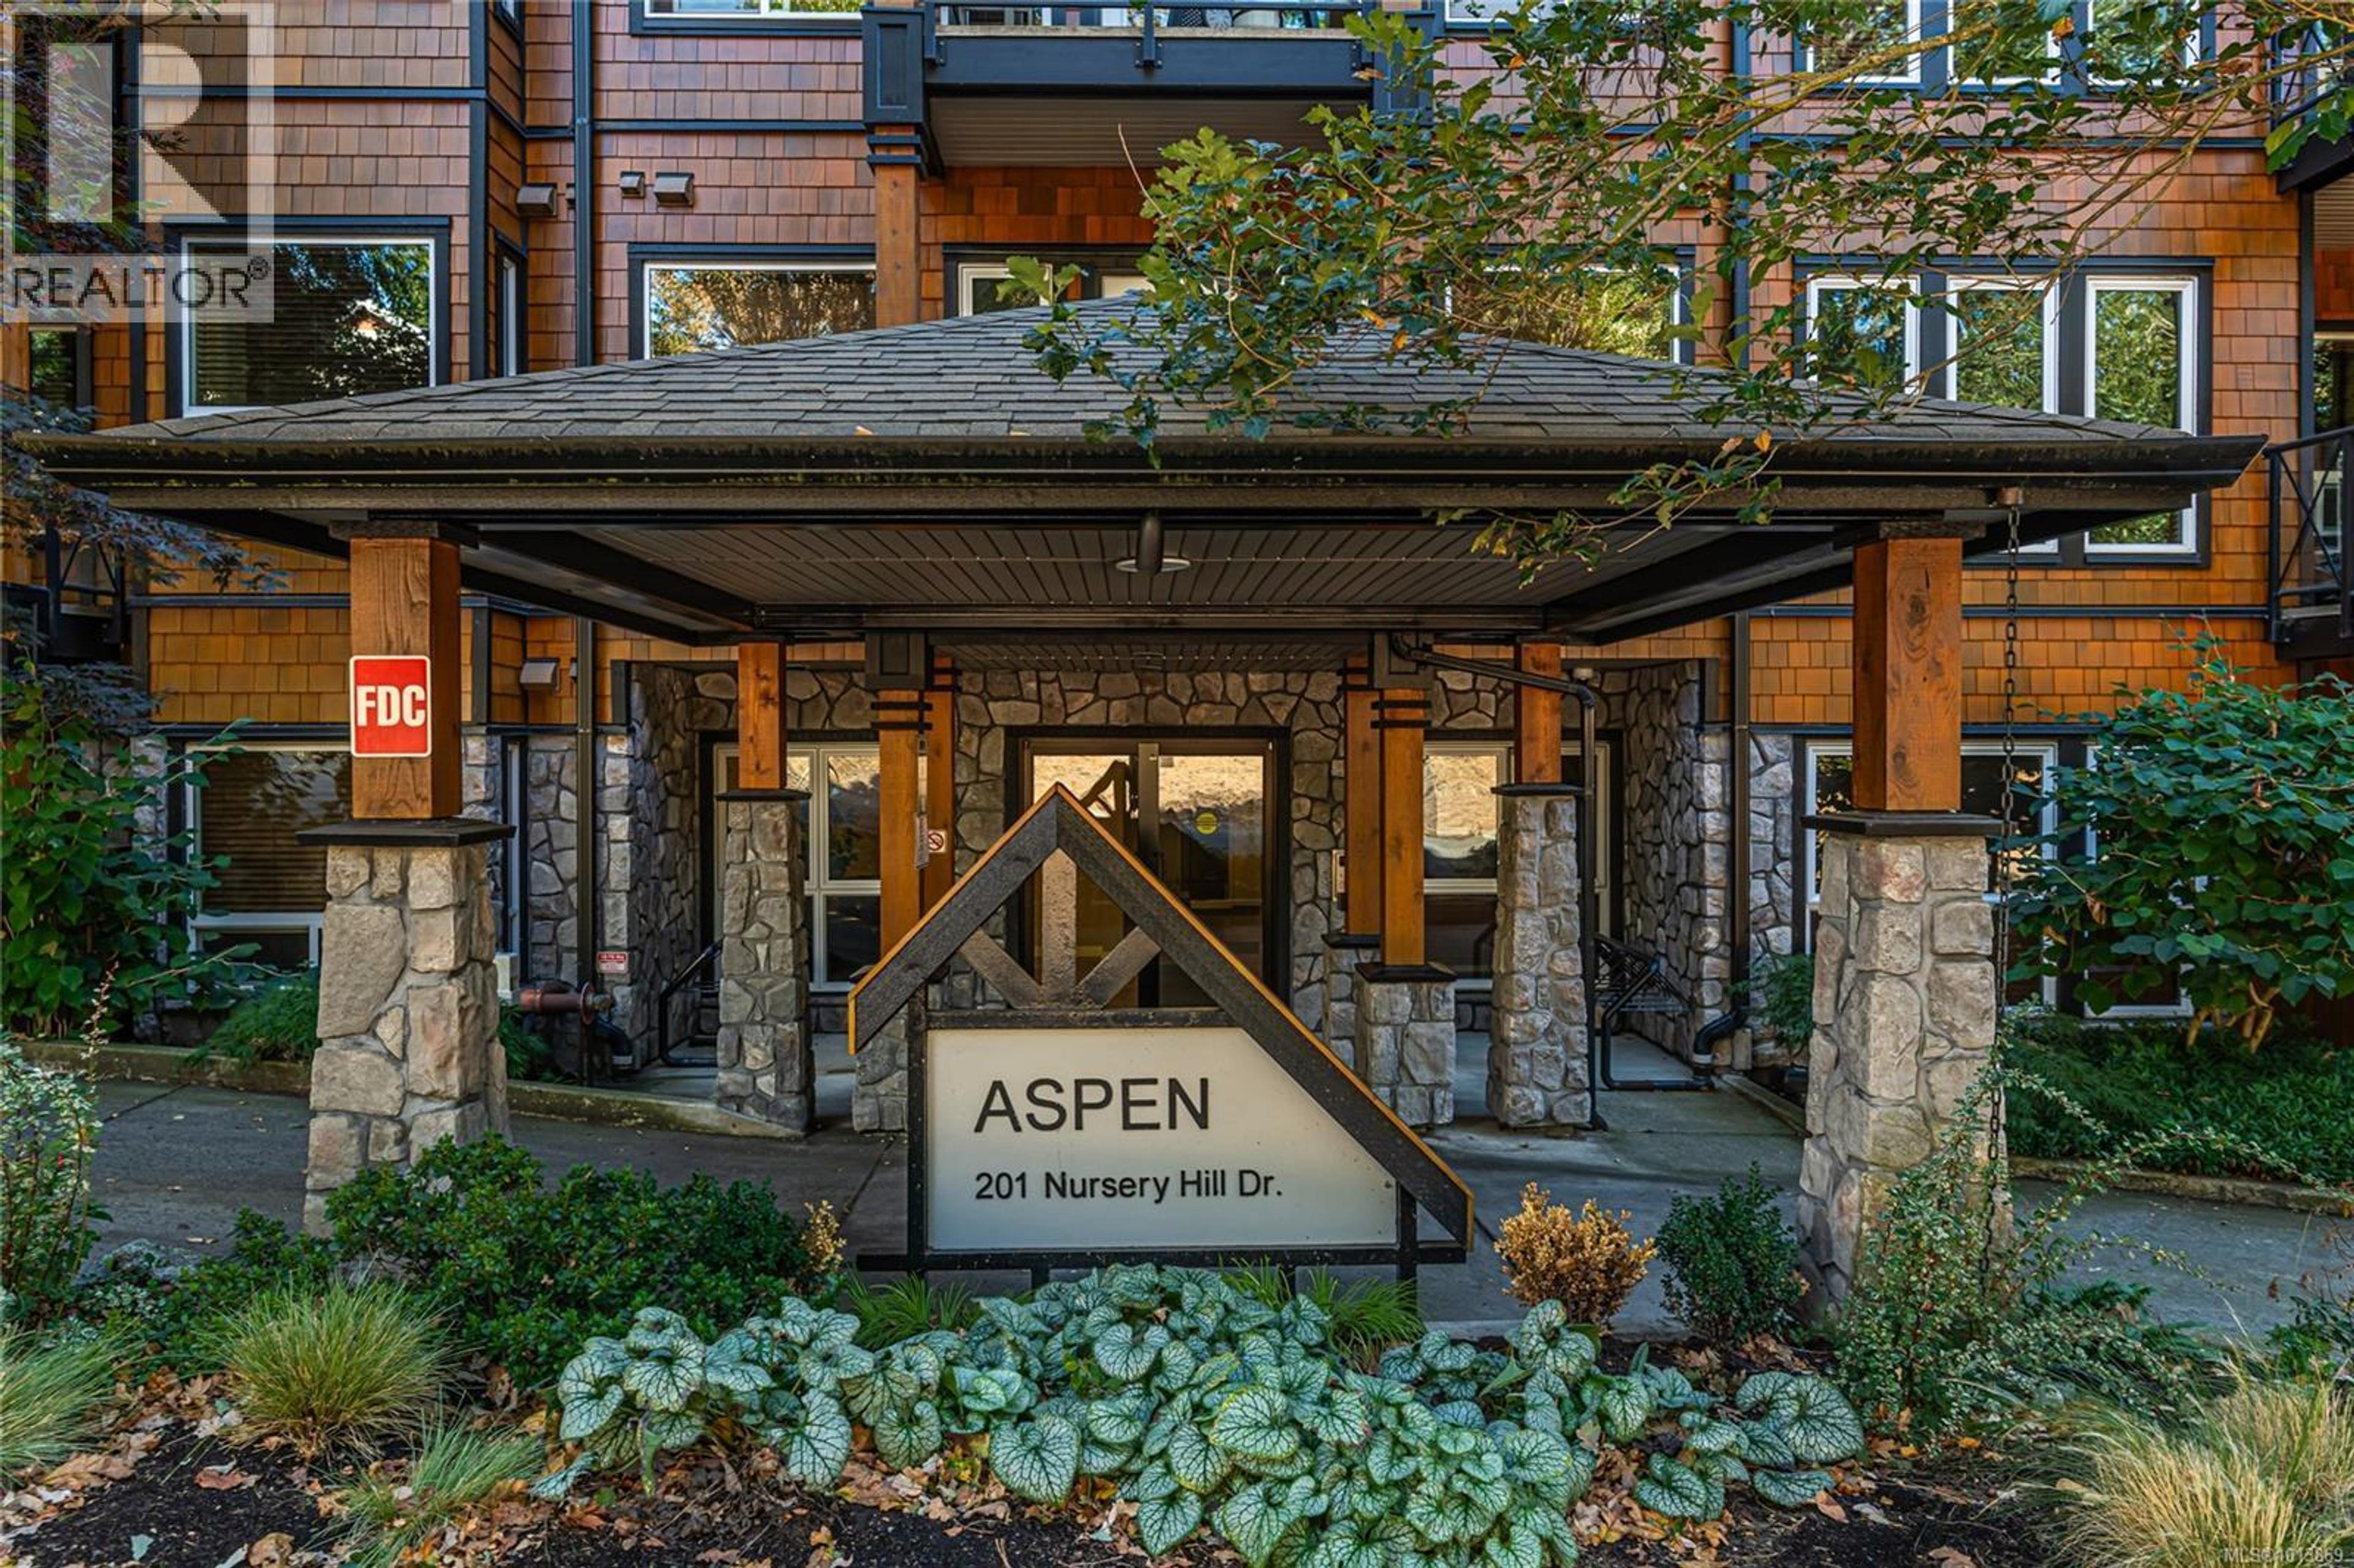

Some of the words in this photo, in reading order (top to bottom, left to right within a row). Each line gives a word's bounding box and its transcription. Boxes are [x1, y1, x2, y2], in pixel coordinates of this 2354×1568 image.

[357, 685, 425, 726] FDC
[973, 1078, 1209, 1133] ASPEN
[975, 1171, 1026, 1200] 201
[1045, 1171, 1170, 1205] Nursery
[1180, 1169, 1226, 1197] Hill
[1238, 1169, 1282, 1197] Dr.
